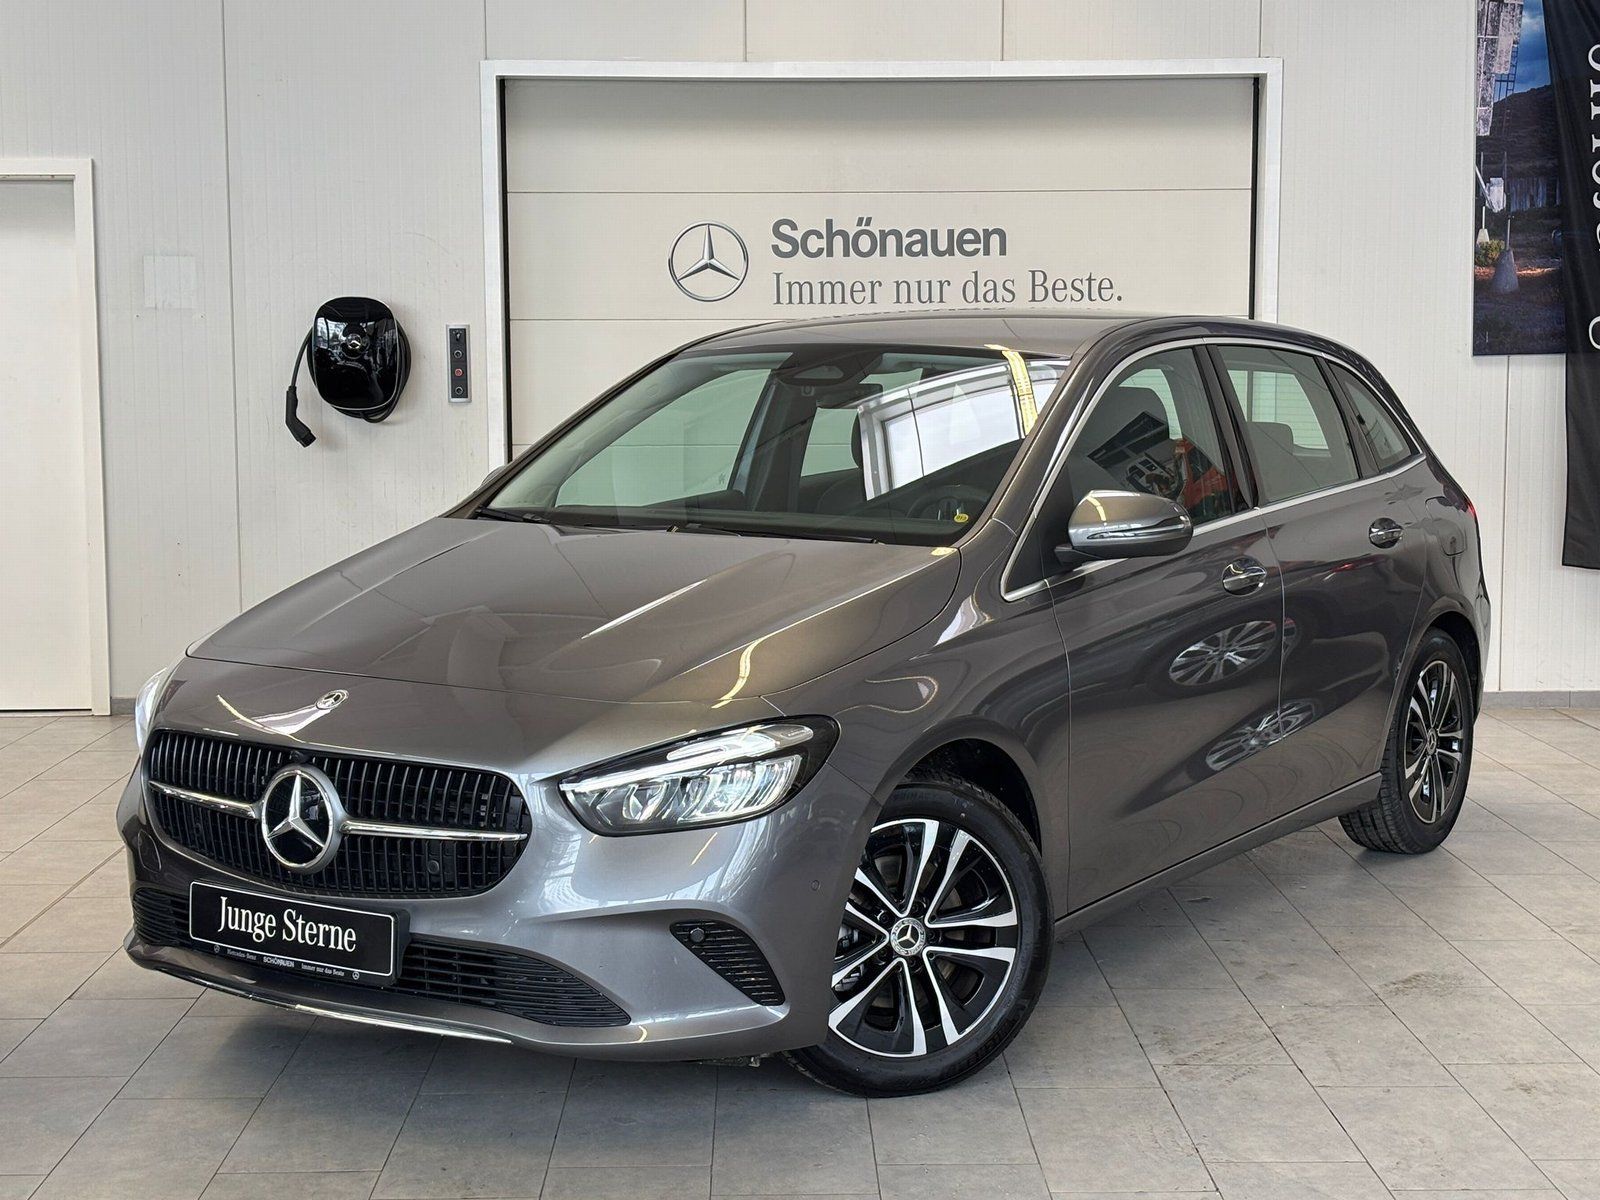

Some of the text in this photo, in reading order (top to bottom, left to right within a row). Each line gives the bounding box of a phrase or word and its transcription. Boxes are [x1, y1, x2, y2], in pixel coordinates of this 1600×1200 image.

[771, 216, 1007, 258] Schönauen
[773, 269, 1123, 305] Immer nur das Beste.
[218, 896, 357, 953] Junge Sterne
